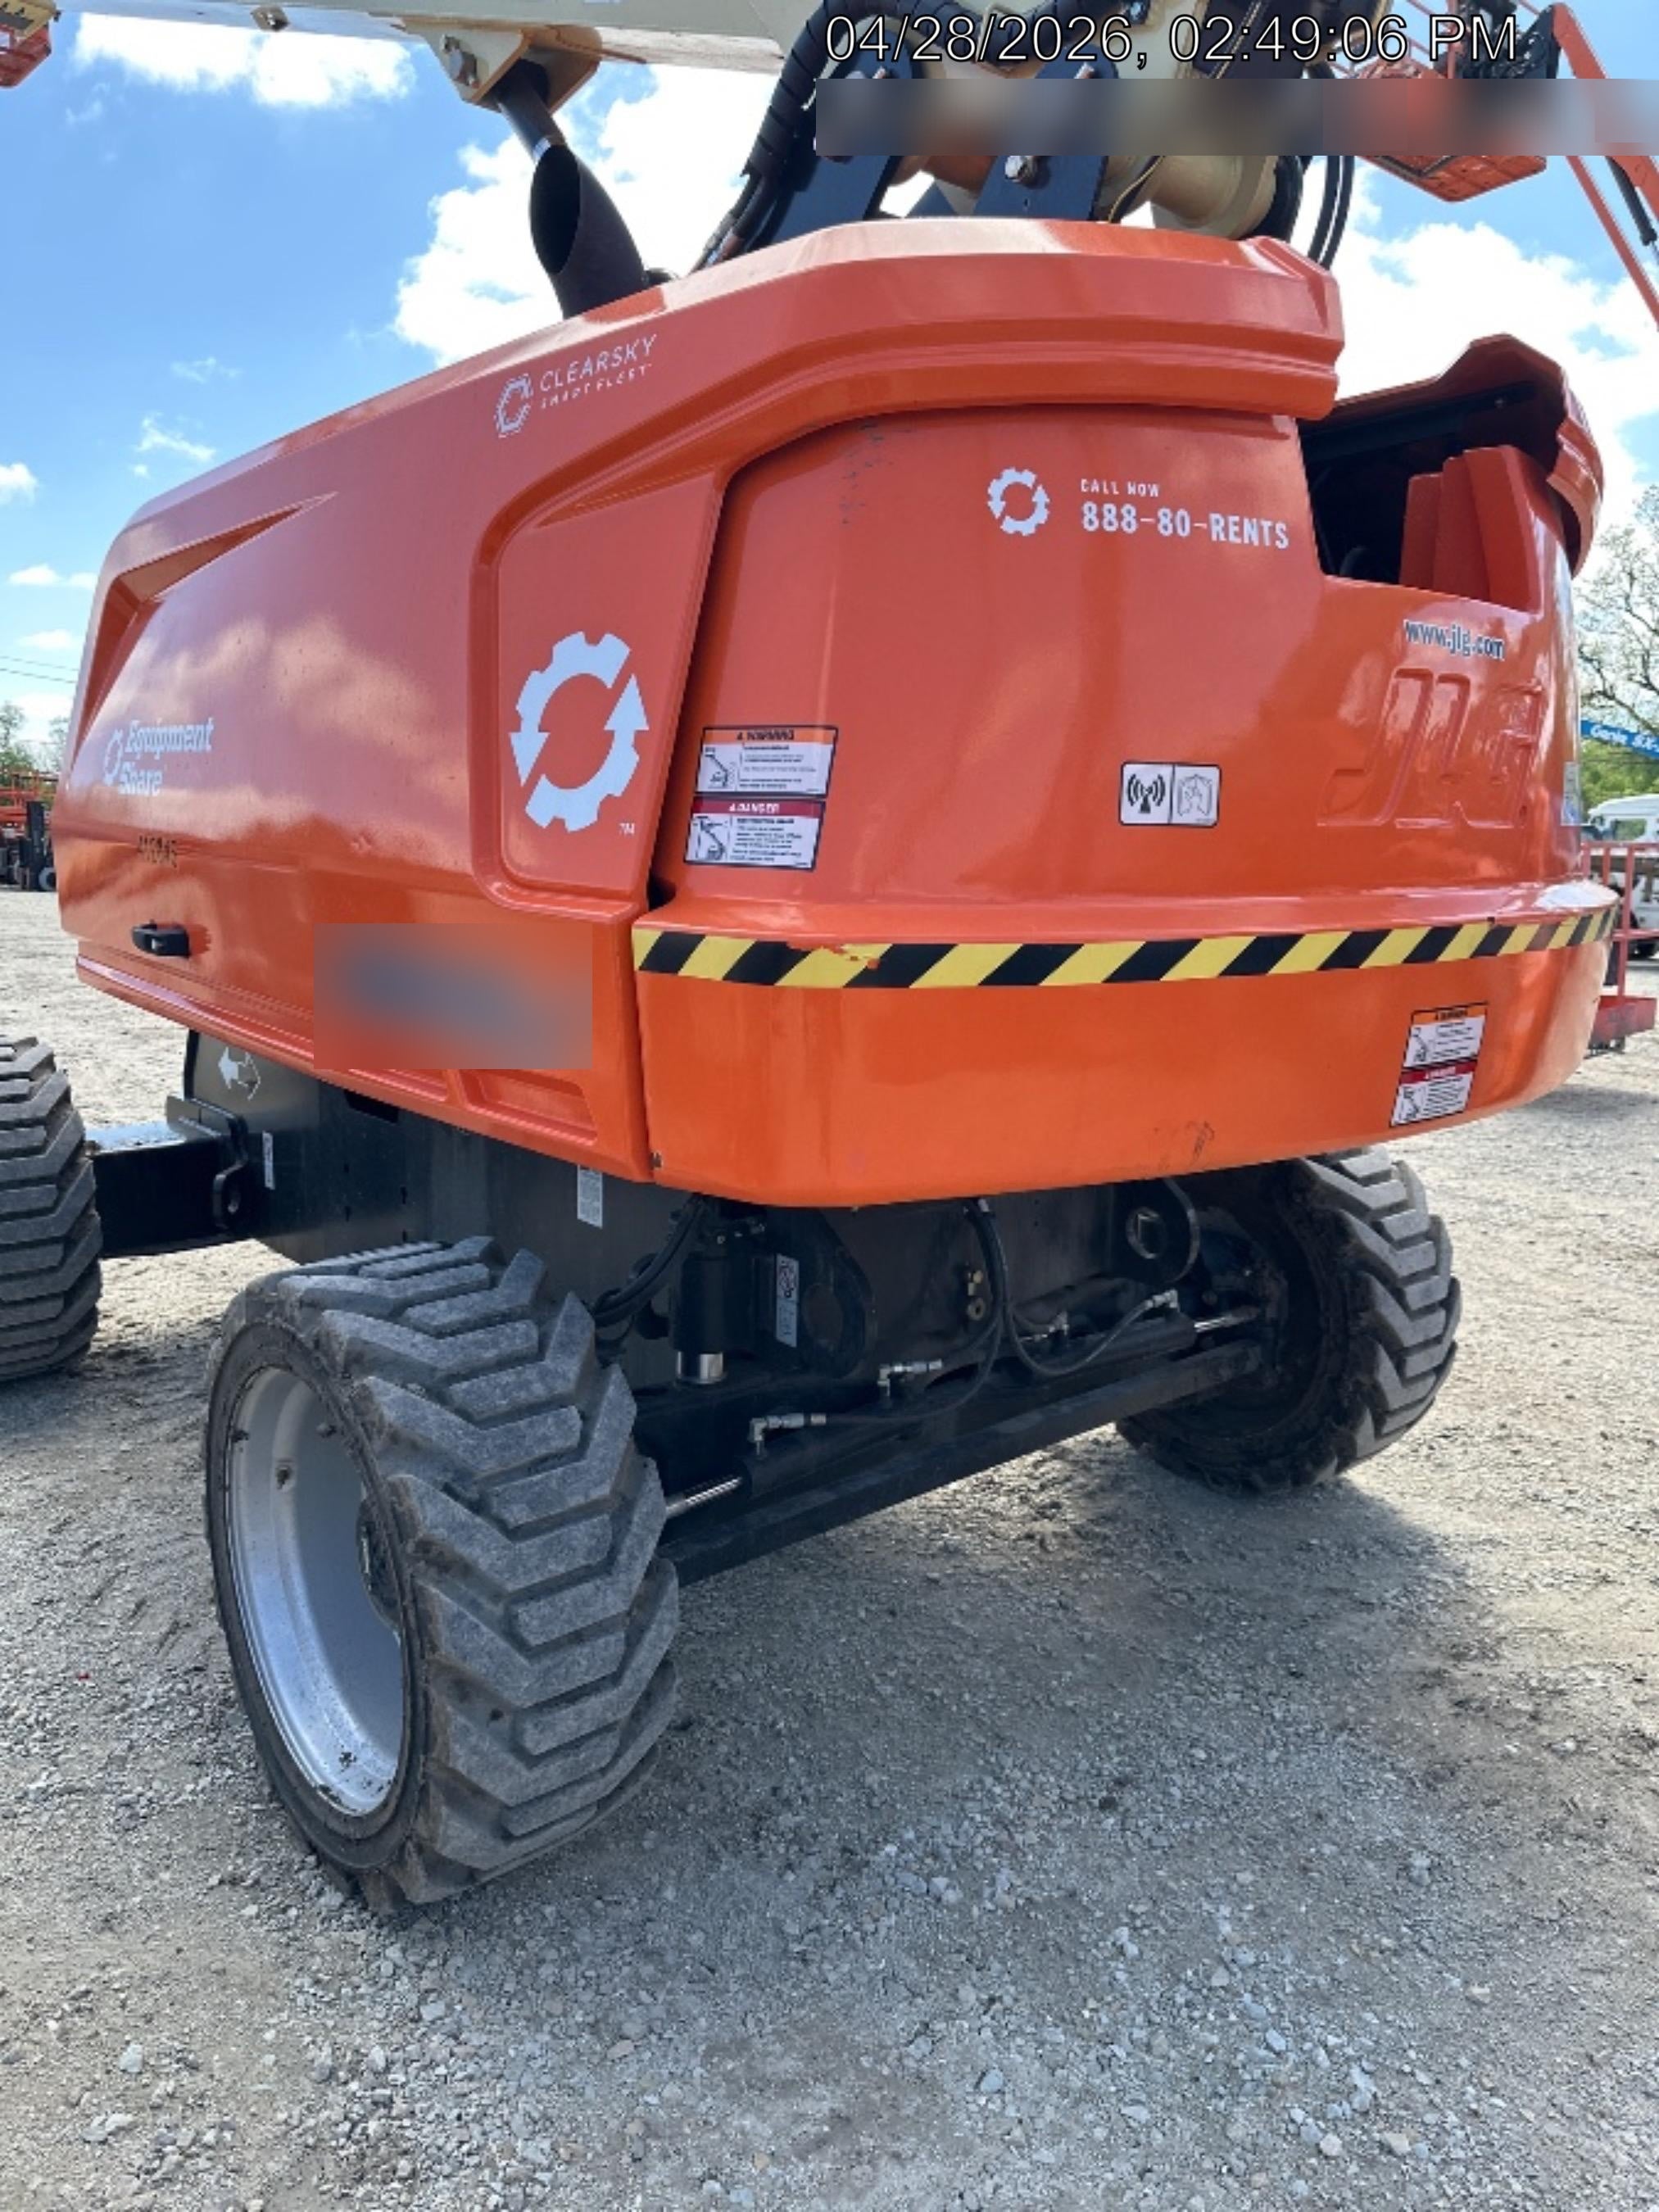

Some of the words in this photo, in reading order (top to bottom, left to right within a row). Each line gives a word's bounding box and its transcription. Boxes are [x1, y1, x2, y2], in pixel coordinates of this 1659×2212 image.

[539, 333, 658, 392] CLEARSKY
[1081, 478, 1120, 495] CALL
[1127, 482, 1160, 497] NOW
[1081, 501, 1290, 550] 888-80-RENTS
[1403, 619, 1506, 660] www.jlg.com
[124, 717, 215, 760] Equipment
[117, 761, 164, 796] Share
